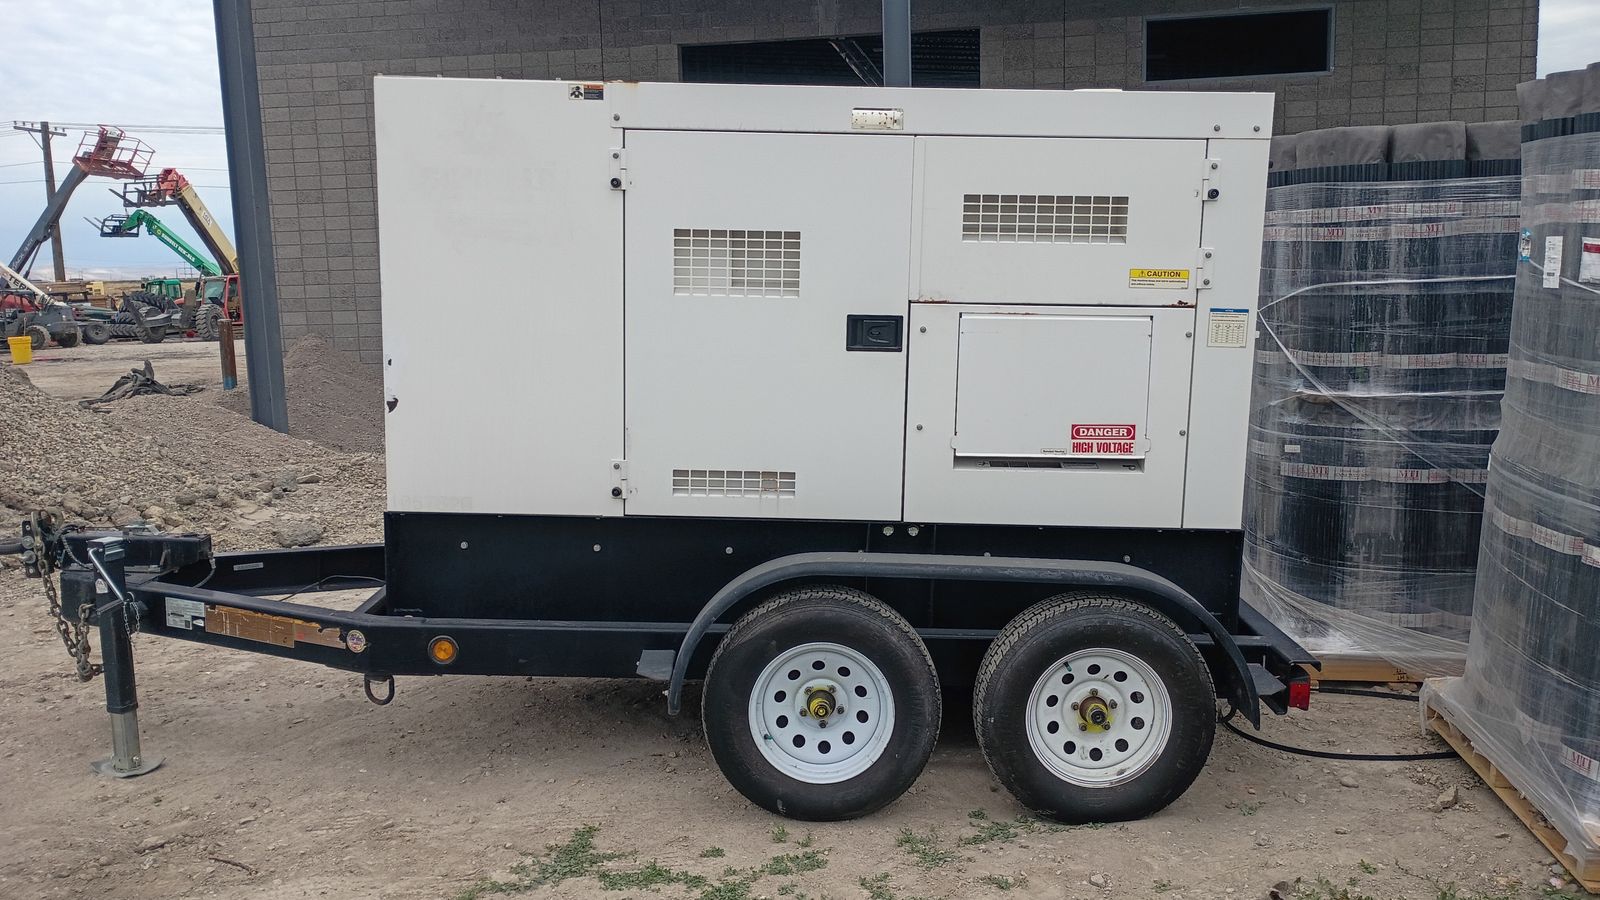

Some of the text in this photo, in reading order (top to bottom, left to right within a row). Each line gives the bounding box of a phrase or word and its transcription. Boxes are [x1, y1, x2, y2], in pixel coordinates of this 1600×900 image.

[1146, 270, 1181, 278] CAUTION
[9, 274, 38, 299] TERX
[1079, 428, 1128, 437] DANGER
[1072, 441, 1134, 454] HIGH VOLTAGE
